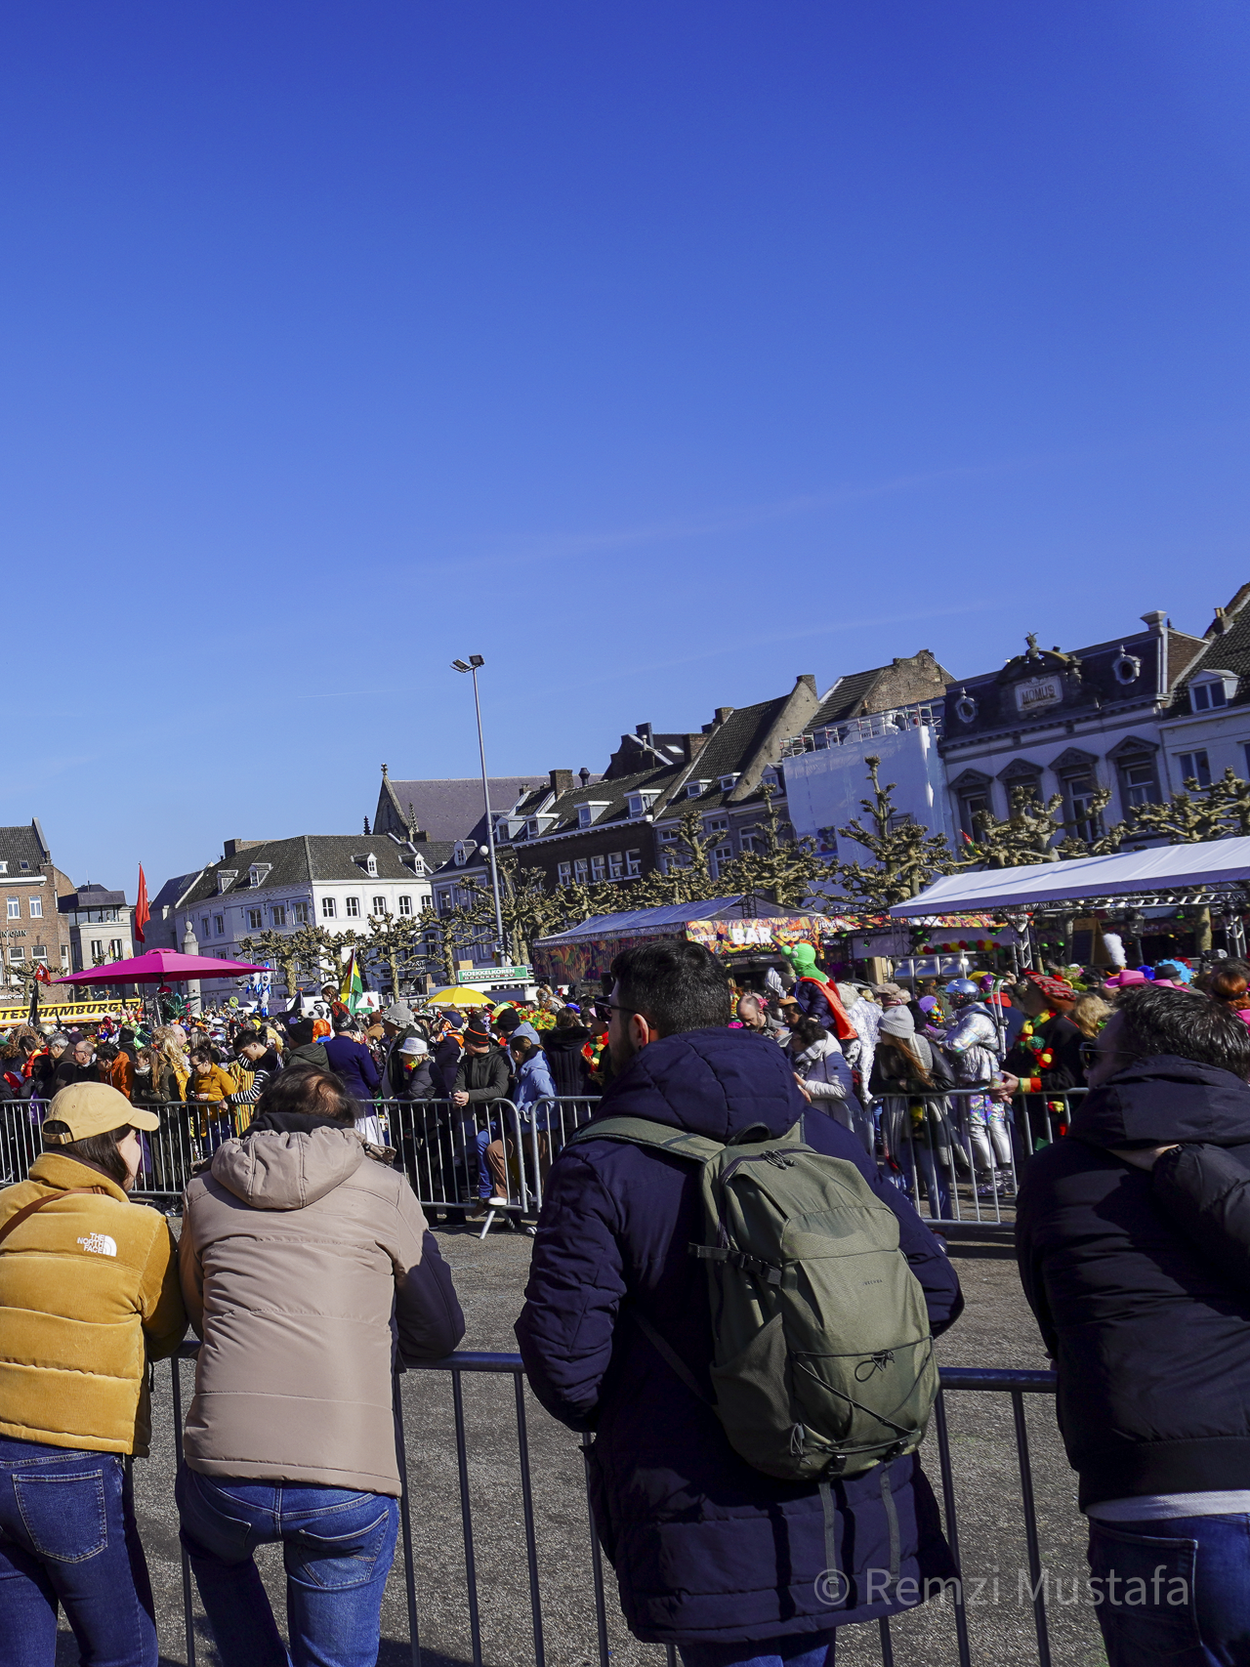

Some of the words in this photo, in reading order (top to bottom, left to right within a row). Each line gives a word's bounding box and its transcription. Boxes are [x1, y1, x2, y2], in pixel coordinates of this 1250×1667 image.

[1022, 684, 1057, 704] MOMUS
[732, 927, 773, 944] BAR
[90, 1232, 105, 1240] THE
[77, 1237, 104, 1248] NORTH
[83, 1244, 104, 1254] FACE
